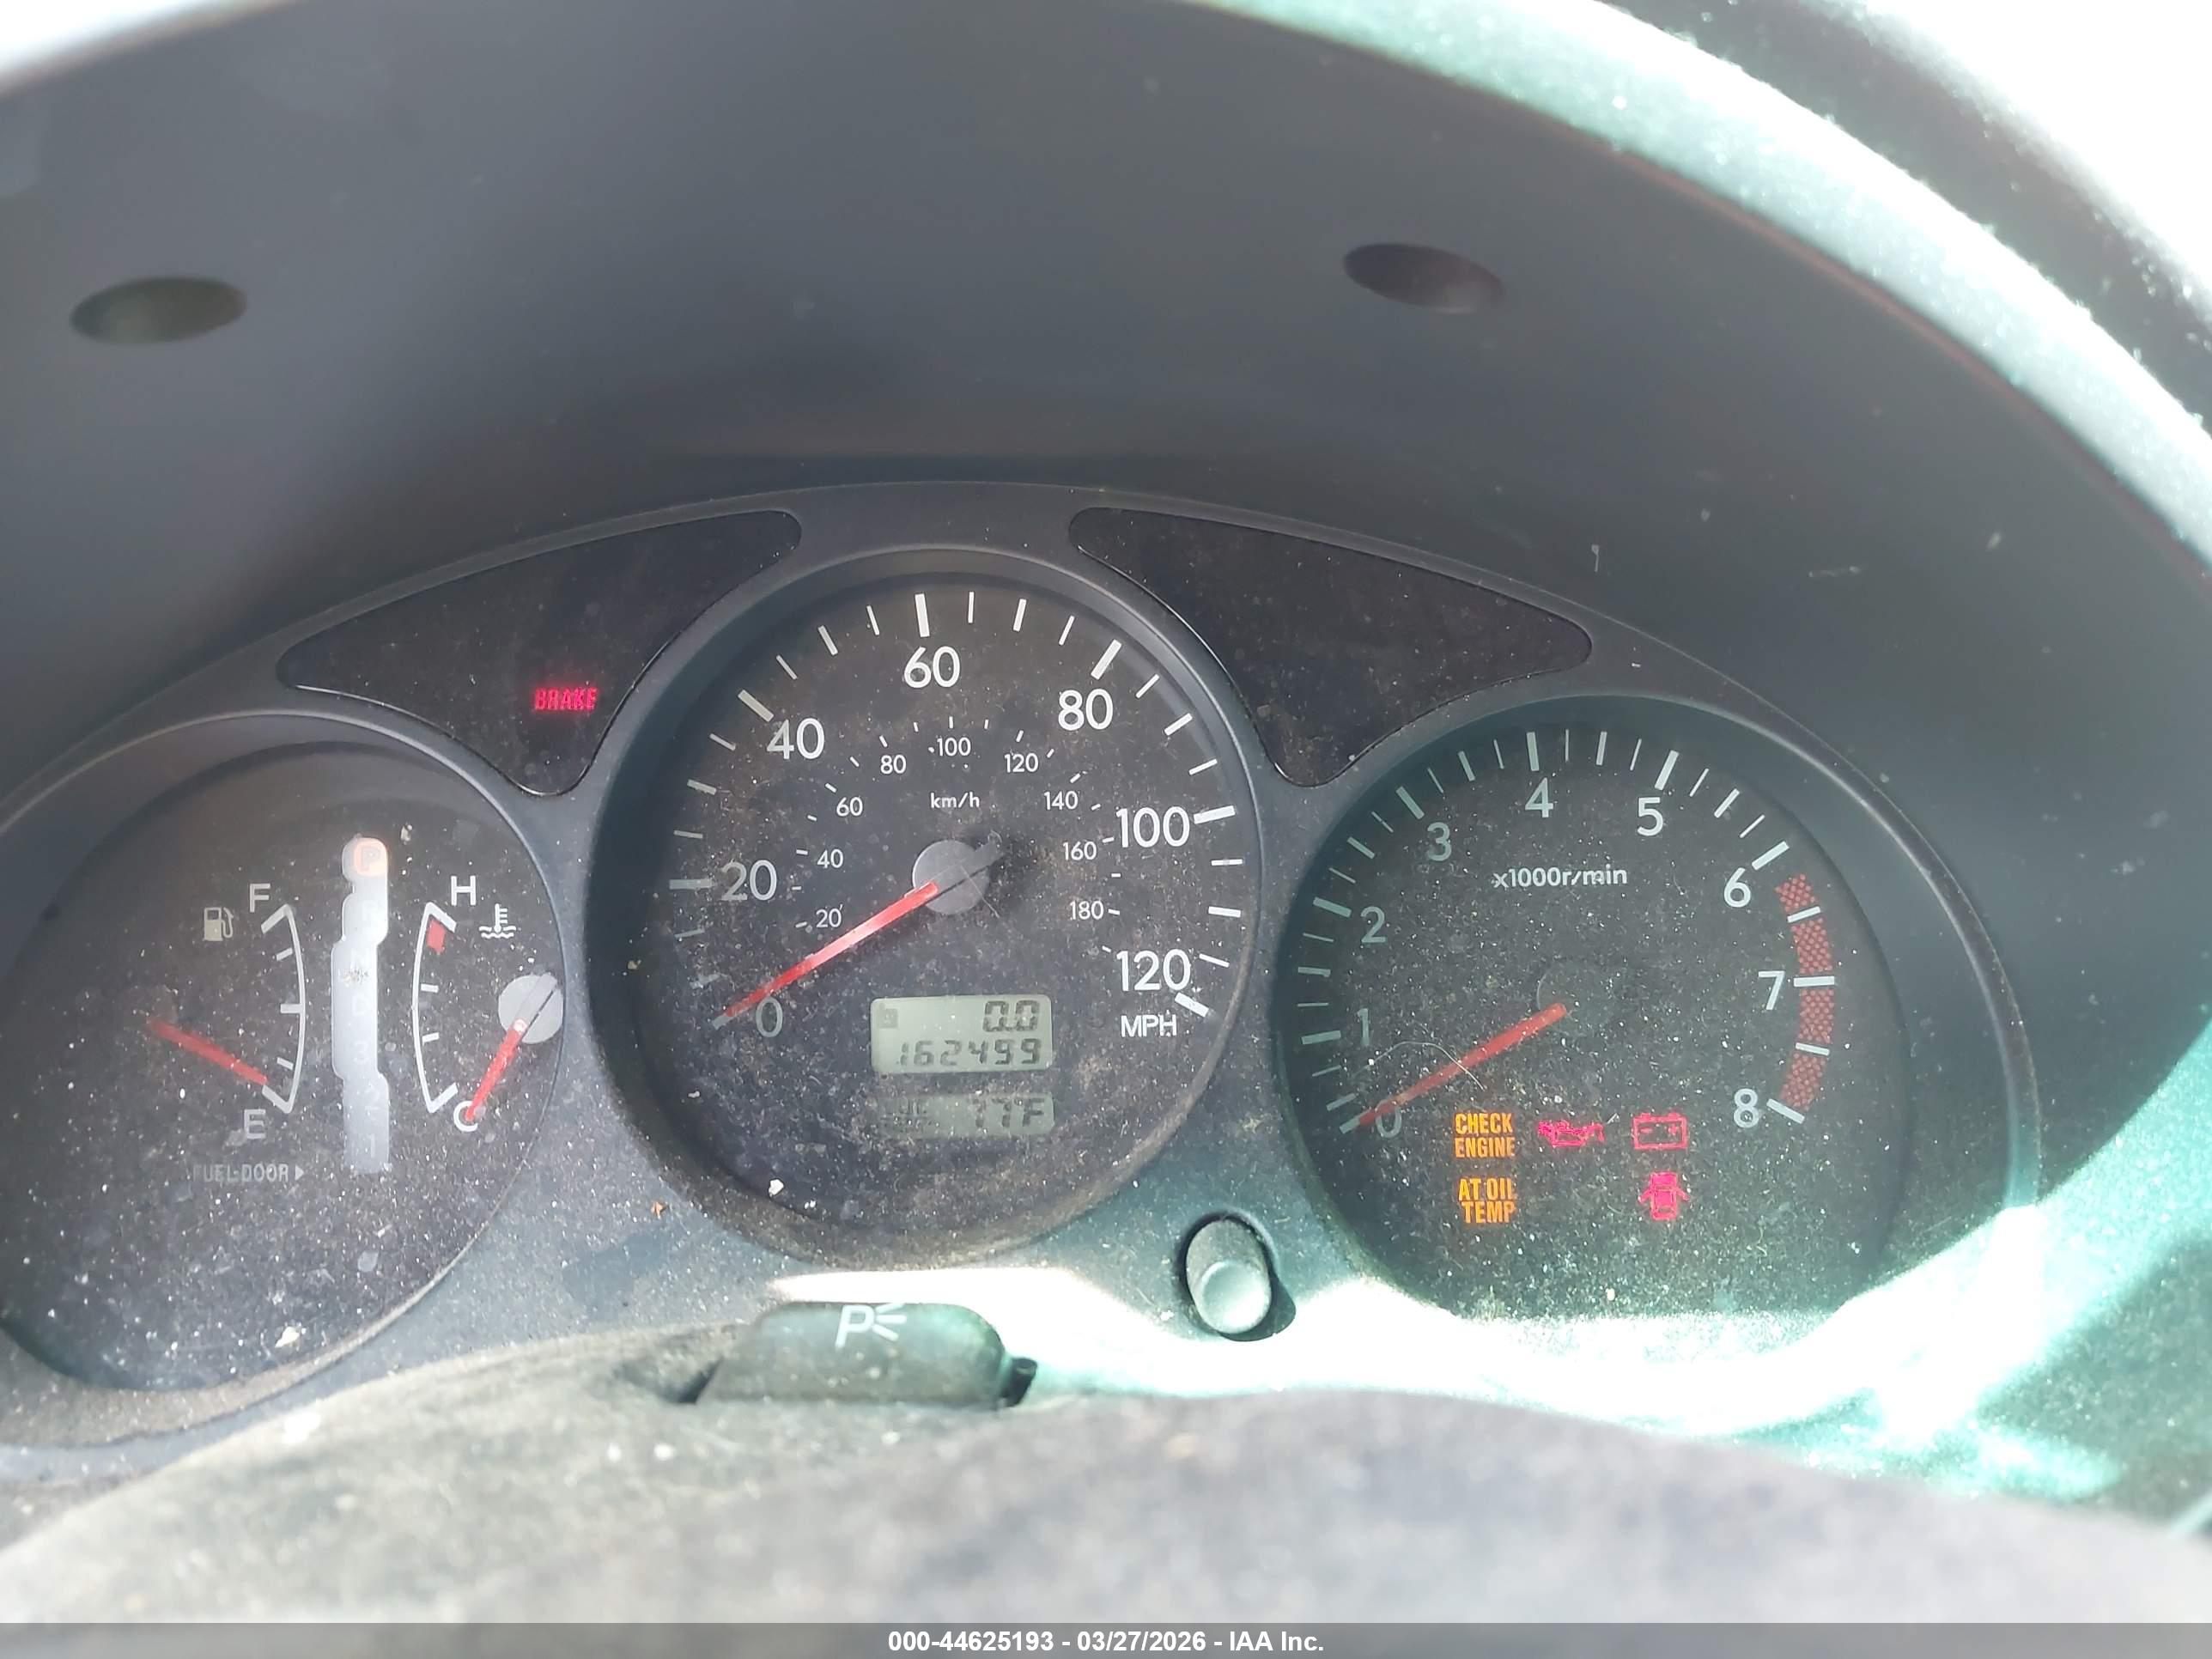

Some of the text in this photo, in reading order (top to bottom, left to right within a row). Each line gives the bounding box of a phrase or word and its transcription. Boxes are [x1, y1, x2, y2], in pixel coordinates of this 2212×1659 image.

[903, 647, 960, 688] 60
[535, 686, 597, 710] BRAKE
[1058, 689, 1113, 730] 80
[767, 718, 824, 759] 40
[937, 738, 971, 757] 100
[880, 755, 907, 775] 80
[1005, 753, 1038, 773] 120
[836, 798, 863, 817] 60
[930, 792, 981, 810] km/h
[1044, 792, 1078, 811] 140
[1525, 777, 1553, 817] 4
[1116, 807, 1189, 848] 100
[1638, 797, 1664, 836] 5
[1063, 842, 1097, 860] 160
[1427, 822, 1451, 861] 3
[361, 845, 380, 872] P
[817, 850, 844, 868] 40
[451, 875, 477, 906] H
[721, 860, 776, 902] 20
[1493, 866, 1627, 889] x1000r/min
[1723, 867, 1751, 908] 6
[249, 883, 270, 912] F
[1070, 901, 1103, 921] 180
[816, 909, 842, 927] 20
[1361, 907, 1387, 943] 2
[1116, 951, 1191, 991] 120
[1758, 970, 1785, 1011] 7
[756, 998, 783, 1037] 0
[983, 1000, 1040, 1032] 0.0
[1121, 1015, 1176, 1036] MPH
[1357, 1009, 1371, 1046] 1
[453, 1100, 479, 1132] C
[1376, 1100, 1402, 1137] 0
[1455, 1113, 1512, 1134] CHECK
[1733, 1088, 1759, 1129] 8
[245, 1109, 266, 1139] E
[1455, 1137, 1515, 1158] ENGINE
[1459, 1177, 1516, 1200] AT OIL
[1462, 1200, 1516, 1223] TEMP
[836, 1304, 875, 1349] P
